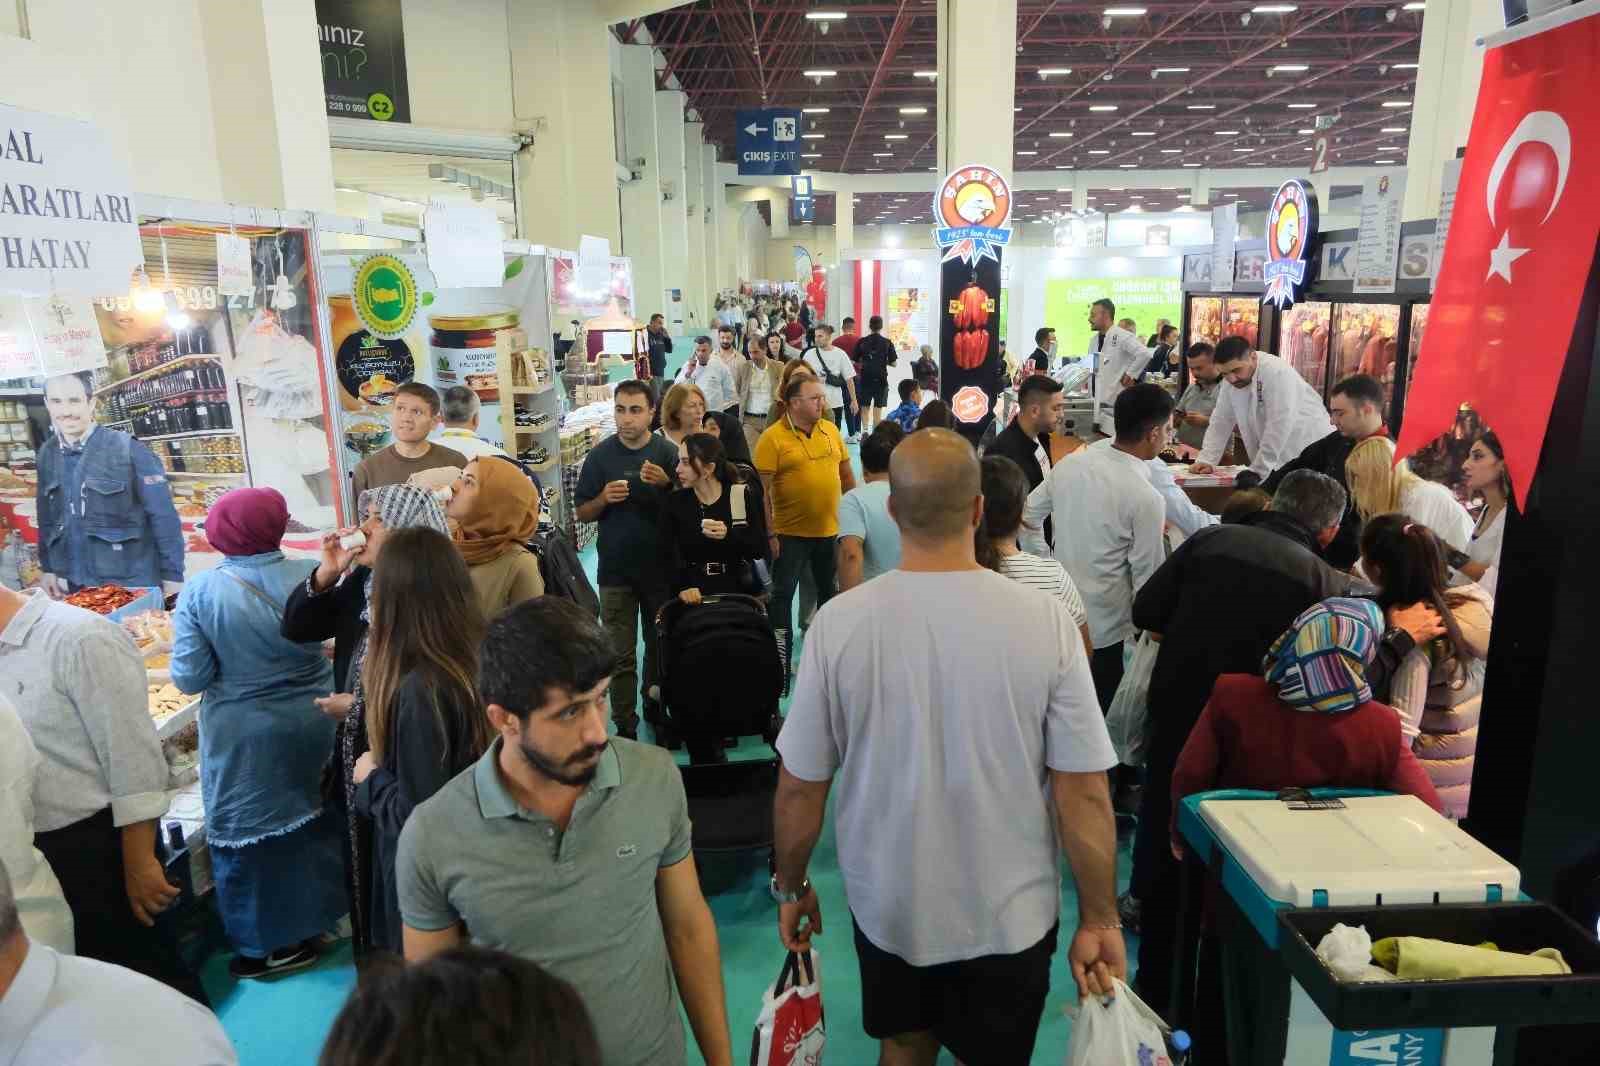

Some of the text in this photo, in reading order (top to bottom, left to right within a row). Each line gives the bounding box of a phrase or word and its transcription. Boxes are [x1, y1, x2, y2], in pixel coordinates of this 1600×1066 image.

[372, 100, 389, 113] C2
[0, 128, 44, 164] AL
[743, 151, 796, 163] ÇIKIŞ EXIT
[1313, 137, 1326, 171] 2
[0, 235, 91, 270] HATAY
